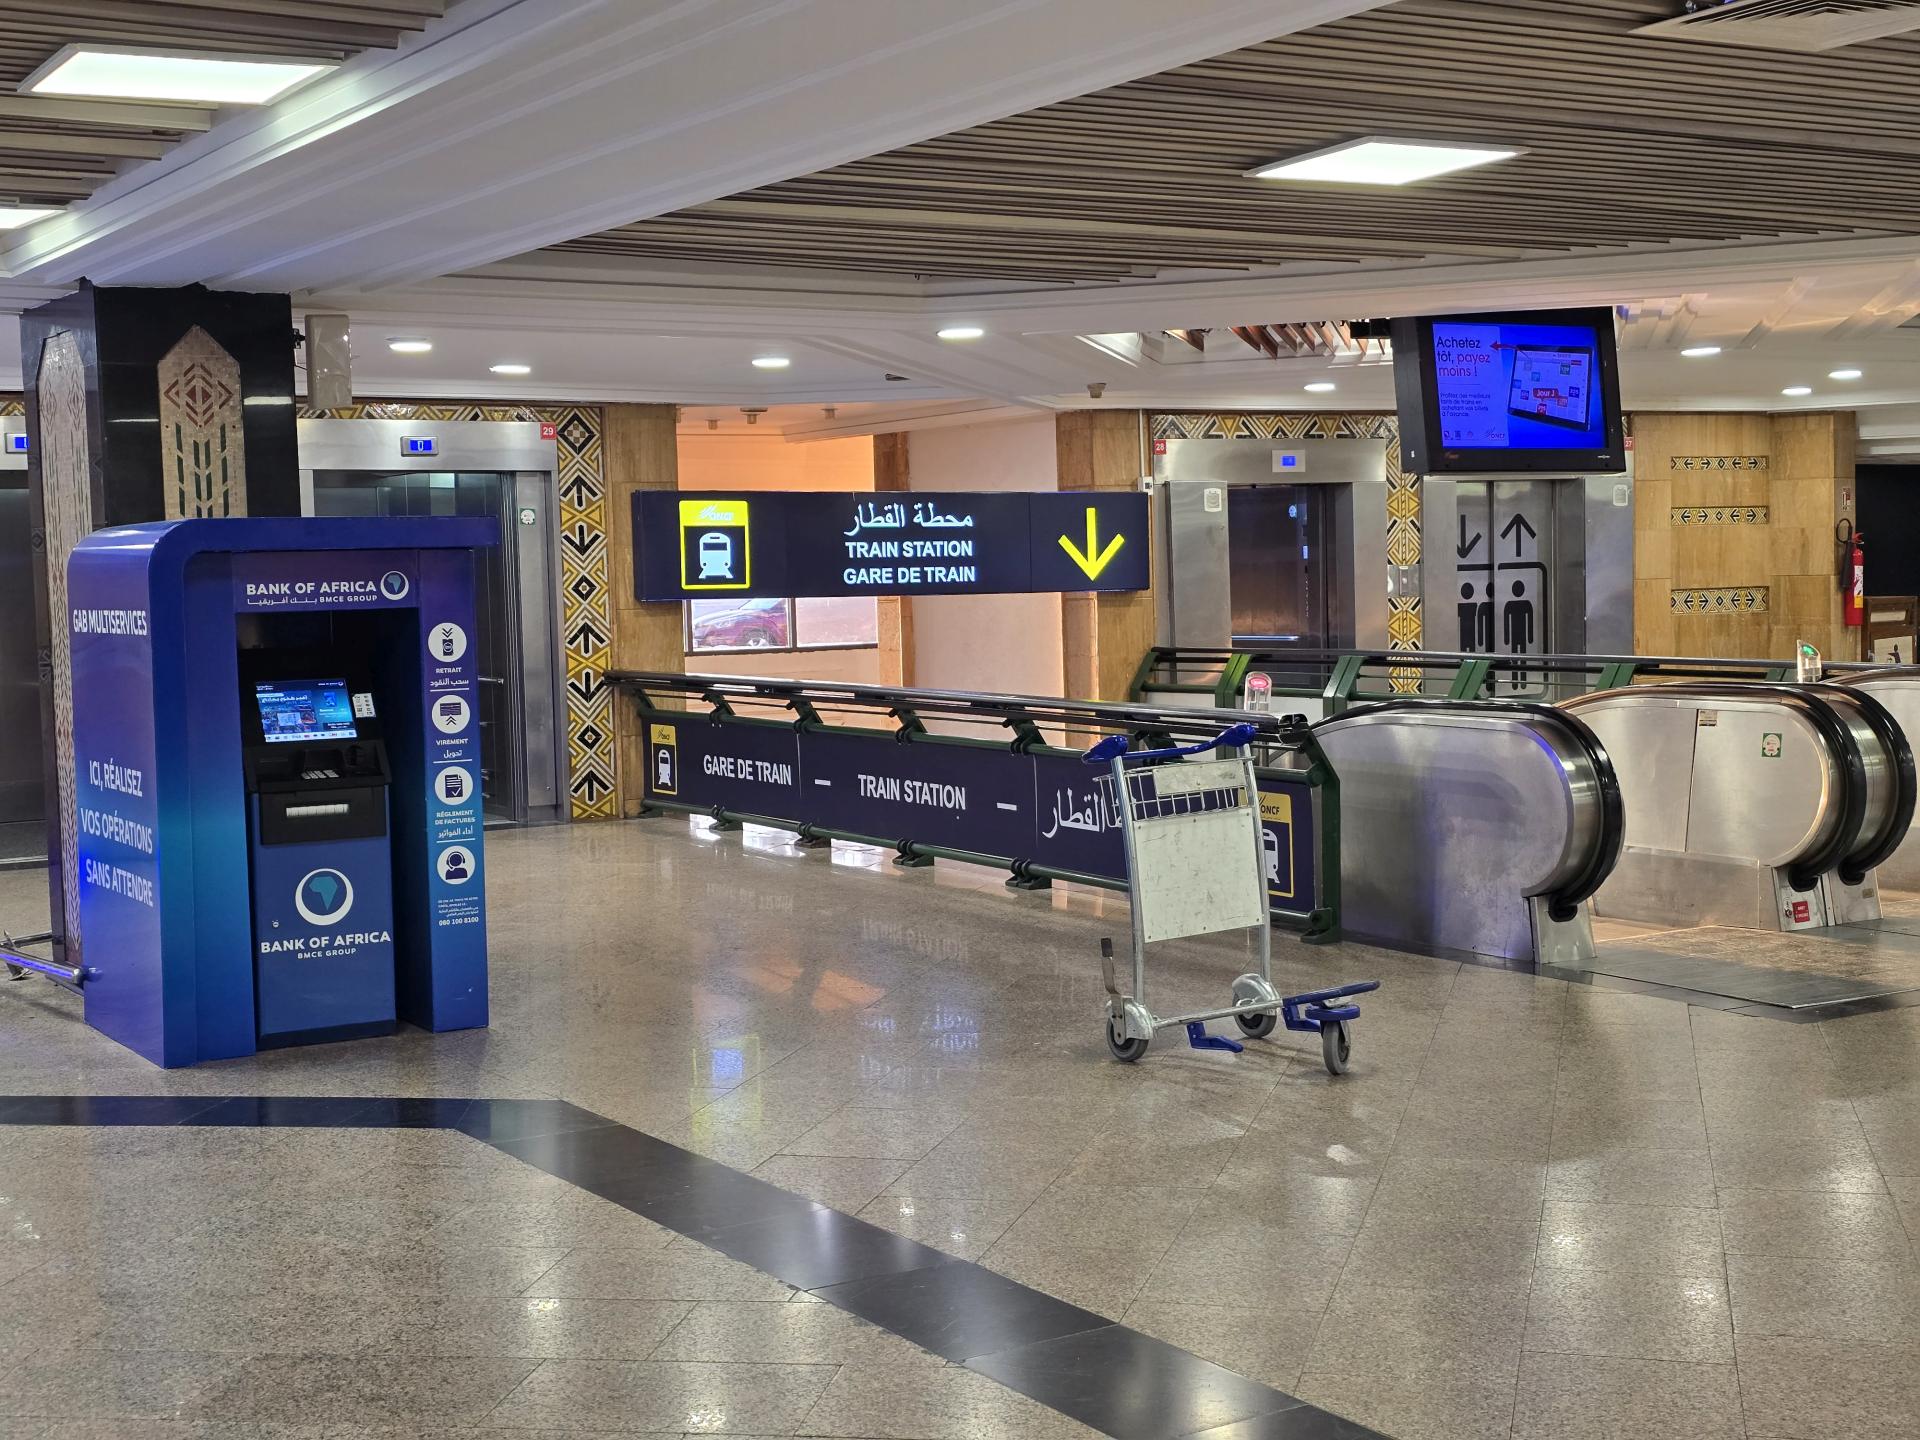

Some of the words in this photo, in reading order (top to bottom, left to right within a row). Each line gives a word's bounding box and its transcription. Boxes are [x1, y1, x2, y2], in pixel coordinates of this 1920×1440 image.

[1436, 336, 1481, 348] Achetez
[1437, 350, 1454, 364] tôt,
[1457, 353, 1490, 365] payez
[1439, 365, 1471, 377] moins
[542, 427, 554, 436] 29
[1156, 443, 1165, 451] 28
[843, 503, 905, 536] القطار
[912, 503, 973, 528] محطة
[845, 541, 898, 559] TRAIN
[902, 540, 973, 558] STATION
[843, 567, 893, 585] GARE
[897, 567, 922, 584] DE
[923, 566, 976, 584] TRAIN
[246, 583, 291, 596] BANK
[294, 582, 316, 594] OF
[319, 581, 377, 593] AFRICA
[347, 595, 378, 603] GROUP
[73, 609, 88, 633] GAB
[88, 609, 148, 636] MULTISERVICES
[430, 677, 450, 688] النقود
[450, 679, 469, 687] سحب
[436, 738, 469, 746] VIREMENT
[443, 749, 463, 759] تحويل
[89, 760, 103, 791] ICI,
[103, 757, 143, 797] RÉALISEZ
[703, 754, 735, 779] GARE
[737, 758, 754, 781] DE
[755, 760, 792, 786] TRAIN
[857, 774, 900, 801] TRAIN
[903, 779, 966, 810] STATION
[1041, 787, 1105, 839] القطار
[1260, 805, 1280, 815] ONCF
[444, 816, 476, 825] FACTURES
[80, 807, 101, 837] VOS
[101, 809, 153, 855] OPÉRATIONS
[85, 858, 111, 890] SANS
[111, 866, 154, 908] ATTENDRE
[260, 938, 305, 954] BANK
[309, 936, 330, 949] OF
[333, 931, 391, 947] AFRICA
[297, 951, 322, 959] BMCE
[325, 947, 357, 957] GROUP
